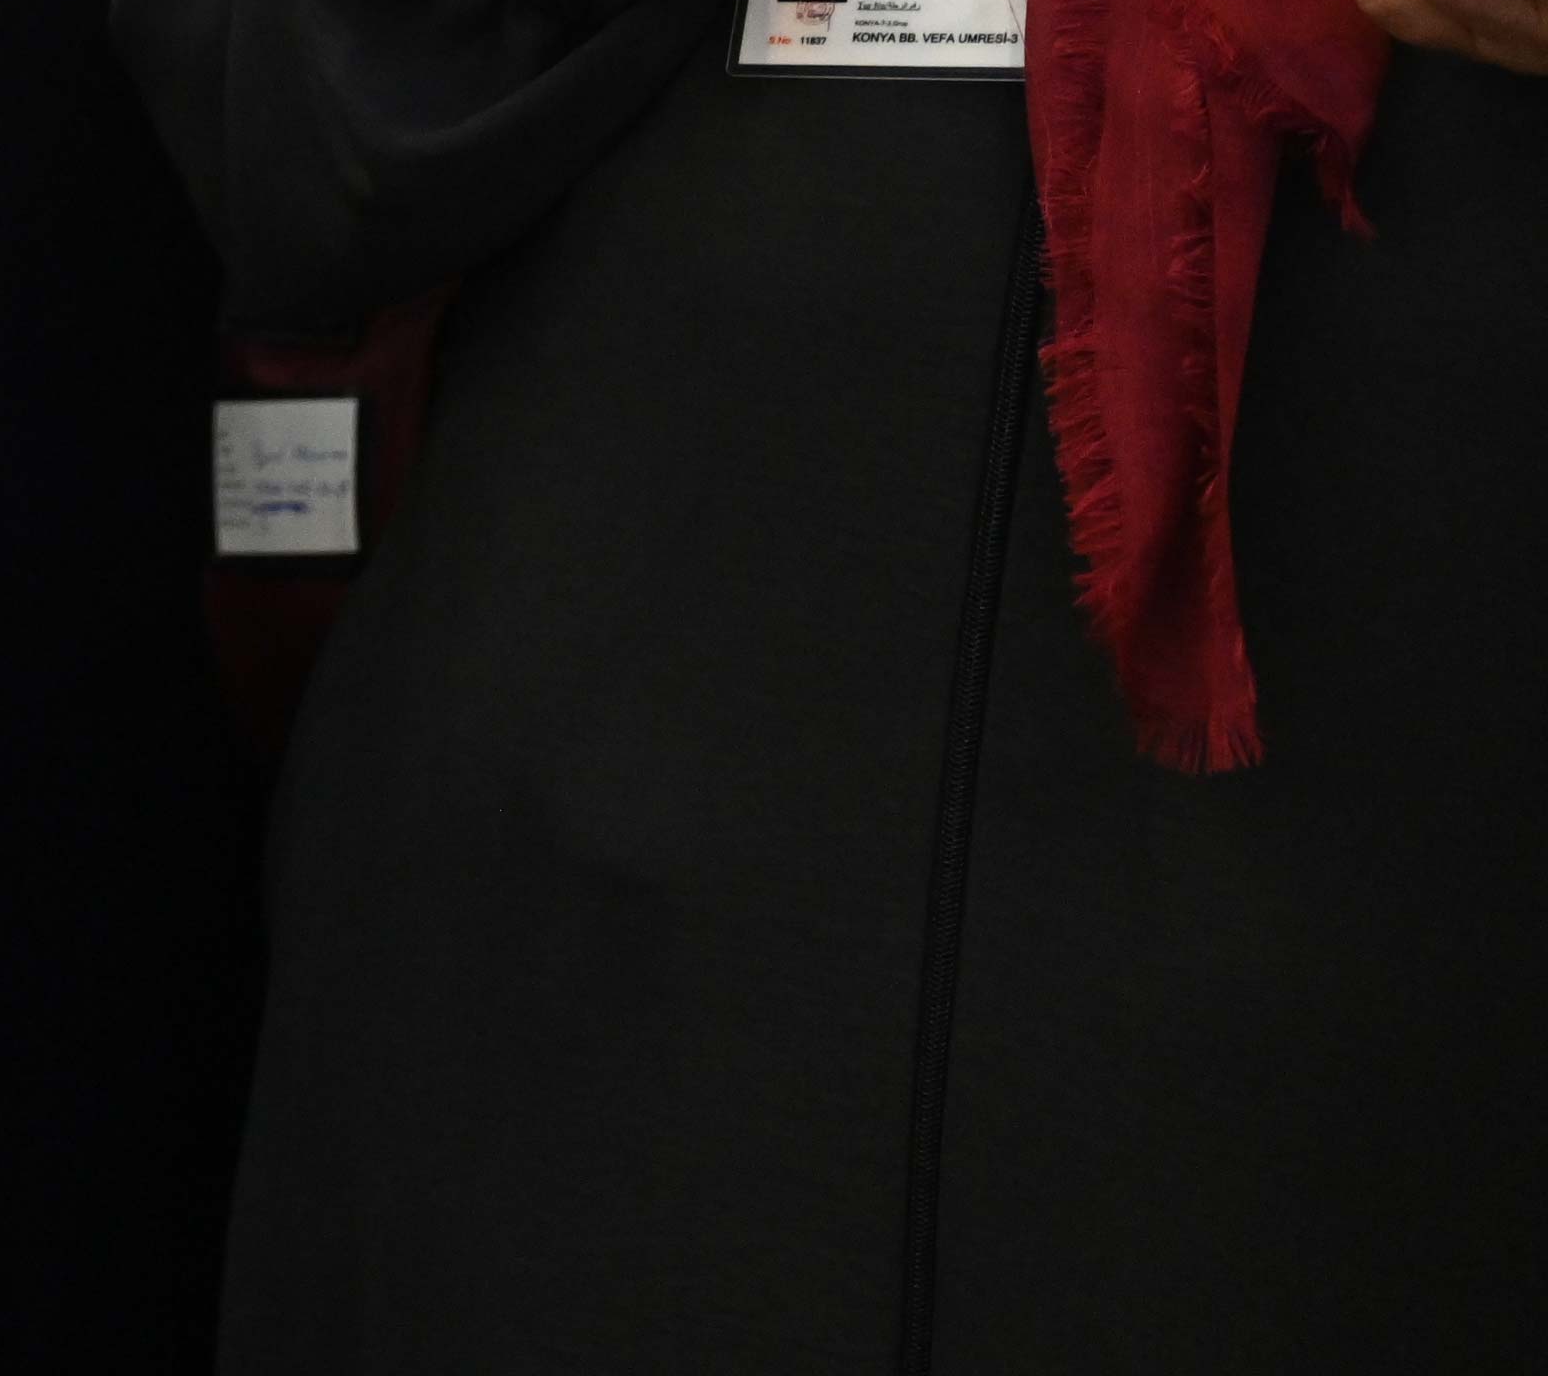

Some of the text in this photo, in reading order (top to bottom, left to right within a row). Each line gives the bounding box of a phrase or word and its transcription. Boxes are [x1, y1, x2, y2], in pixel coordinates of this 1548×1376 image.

[801, 36, 827, 45] 11837
[852, 32, 1019, 44] KONYA BB. VEFA UMRESİ-3
